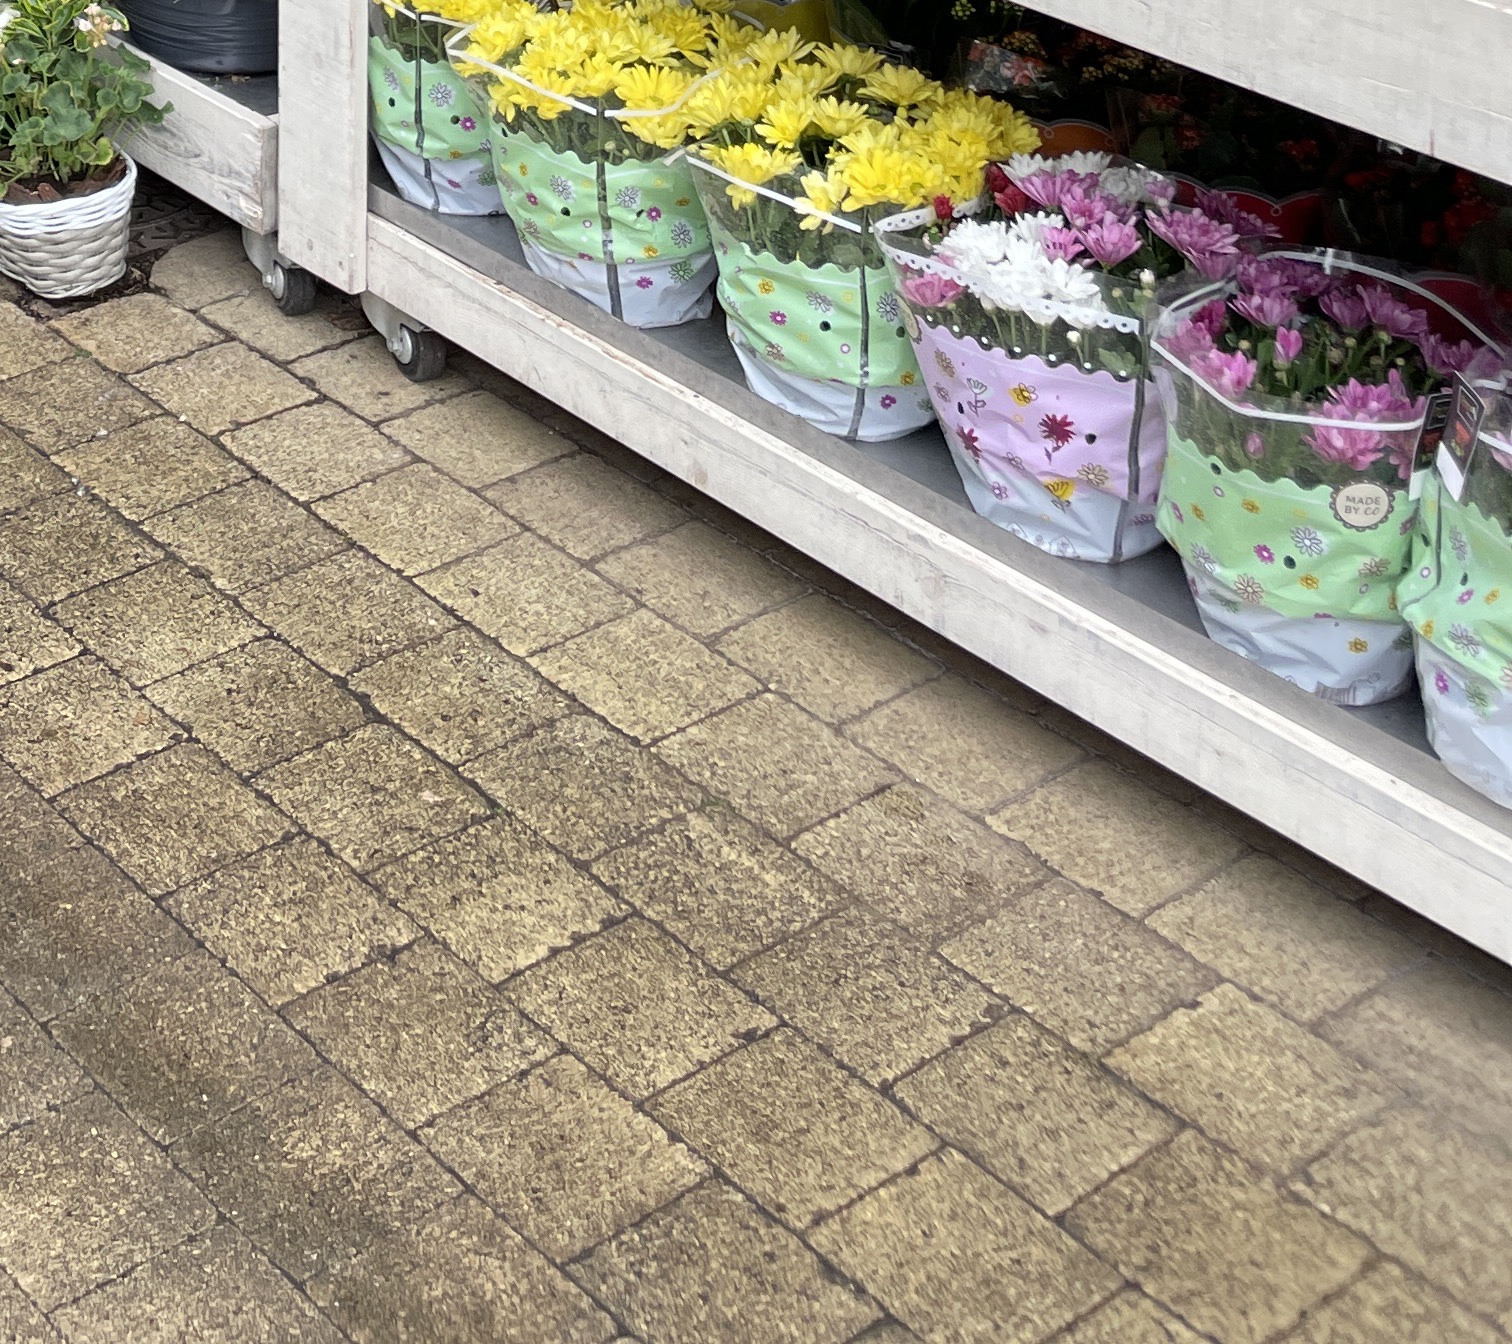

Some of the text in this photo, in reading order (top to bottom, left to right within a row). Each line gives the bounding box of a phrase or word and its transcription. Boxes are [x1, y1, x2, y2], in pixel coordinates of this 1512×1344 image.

[1345, 495, 1381, 506] MADE
[1344, 505, 1380, 516] BY CO
